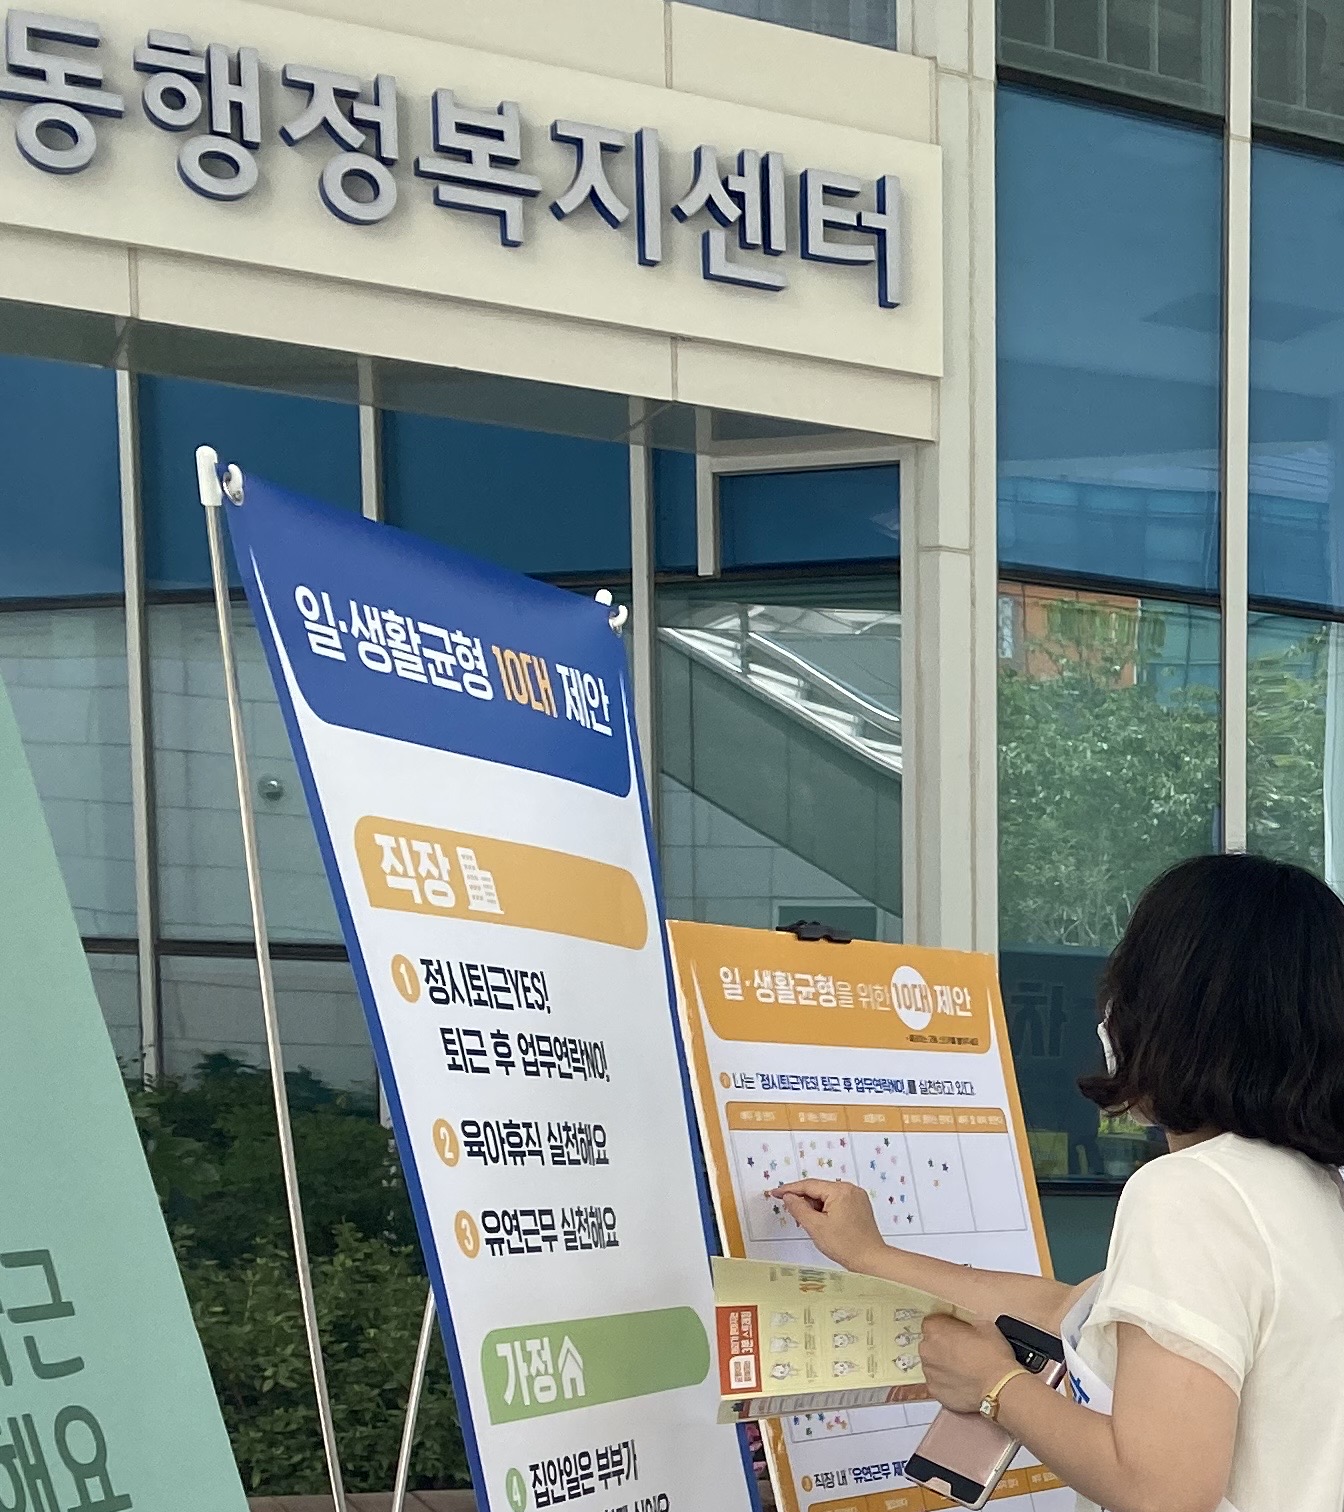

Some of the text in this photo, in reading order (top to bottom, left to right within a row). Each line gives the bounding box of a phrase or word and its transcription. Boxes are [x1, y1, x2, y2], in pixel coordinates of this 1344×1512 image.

[0, 9, 901, 307] 동행정복지센터
[295, 586, 612, 736] 일·생활균형 10대 제안
[374, 834, 455, 908] 직장
[419, 957, 551, 1014] 정시퇴근YES!
[856, 983, 893, 1011] 위한
[892, 983, 932, 1013] 10대
[934, 985, 973, 1017] 제안
[439, 1027, 610, 1082] 퇴근 후 업무연락NO!
[731, 1073, 755, 1089] 나는
[820, 1076, 842, 1092] 퇴근
[842, 1077, 854, 1093] 후
[918, 1080, 954, 1095] 실천하고
[460, 1120, 545, 1167] 육아휴직
[547, 1122, 610, 1167] 실천해요
[481, 1210, 558, 1257] 유연근무
[561, 1206, 619, 1250] 실천해요
[0, 1249, 85, 1386] 근
[496, 1336, 557, 1406] 가정
[529, 1450, 595, 1509] 집안일은
[597, 1440, 639, 1492] 부부가
[814, 1471, 835, 1489] 직장
[836, 1469, 848, 1486] 내
